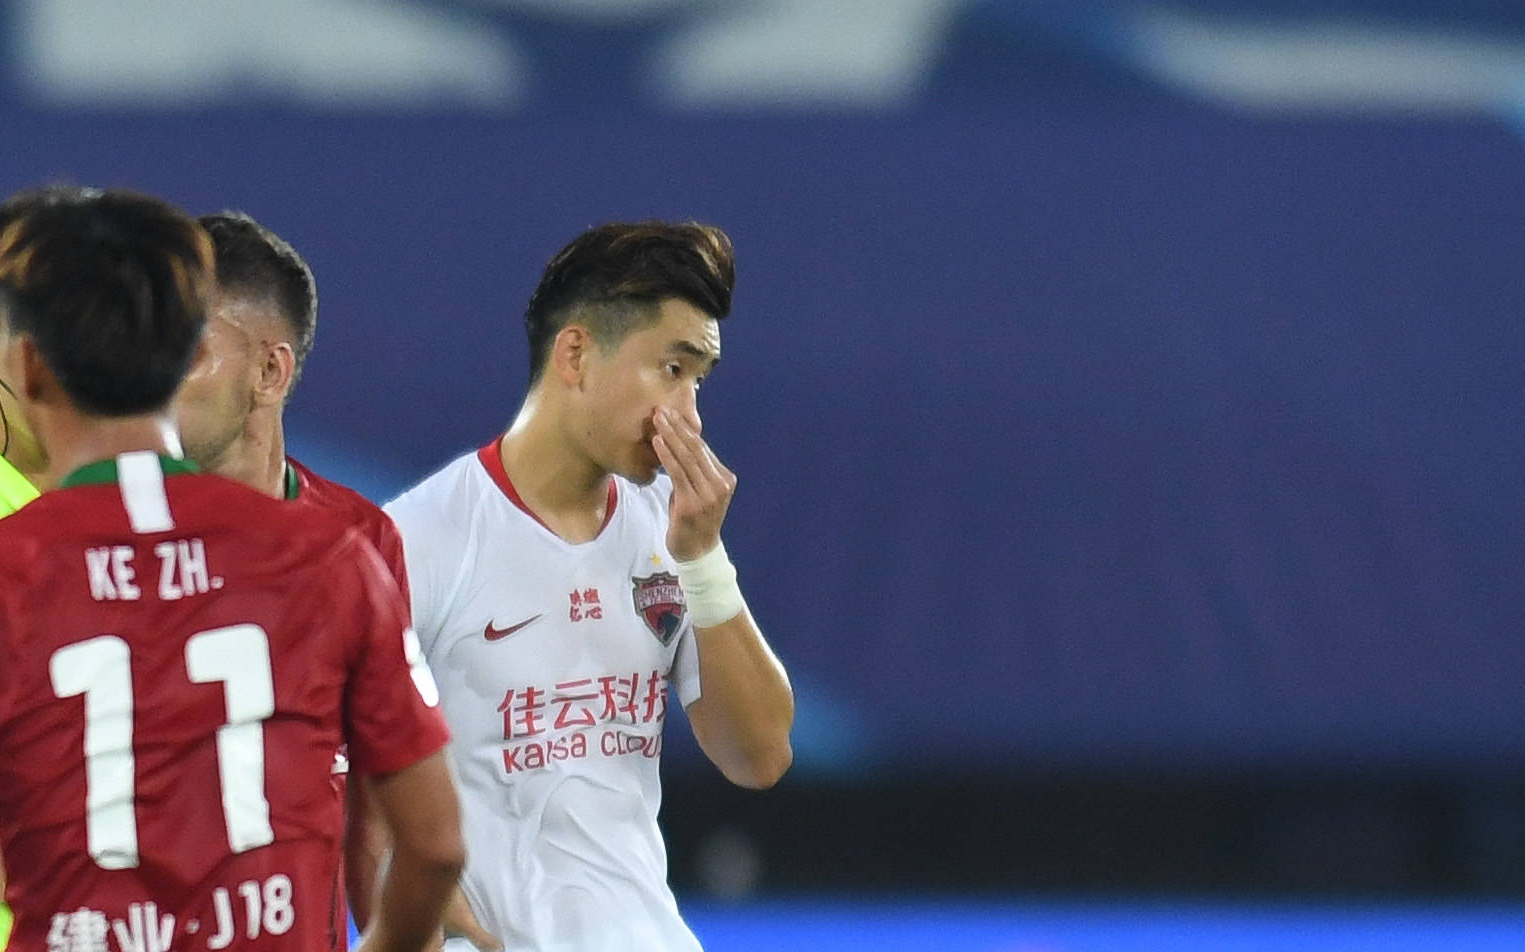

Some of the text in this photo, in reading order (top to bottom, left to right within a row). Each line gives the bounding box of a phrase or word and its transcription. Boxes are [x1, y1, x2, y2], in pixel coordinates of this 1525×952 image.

[84, 537, 224, 601] KE ZH.
[49, 623, 275, 870] 11
[601, 730, 662, 759] CLOU
